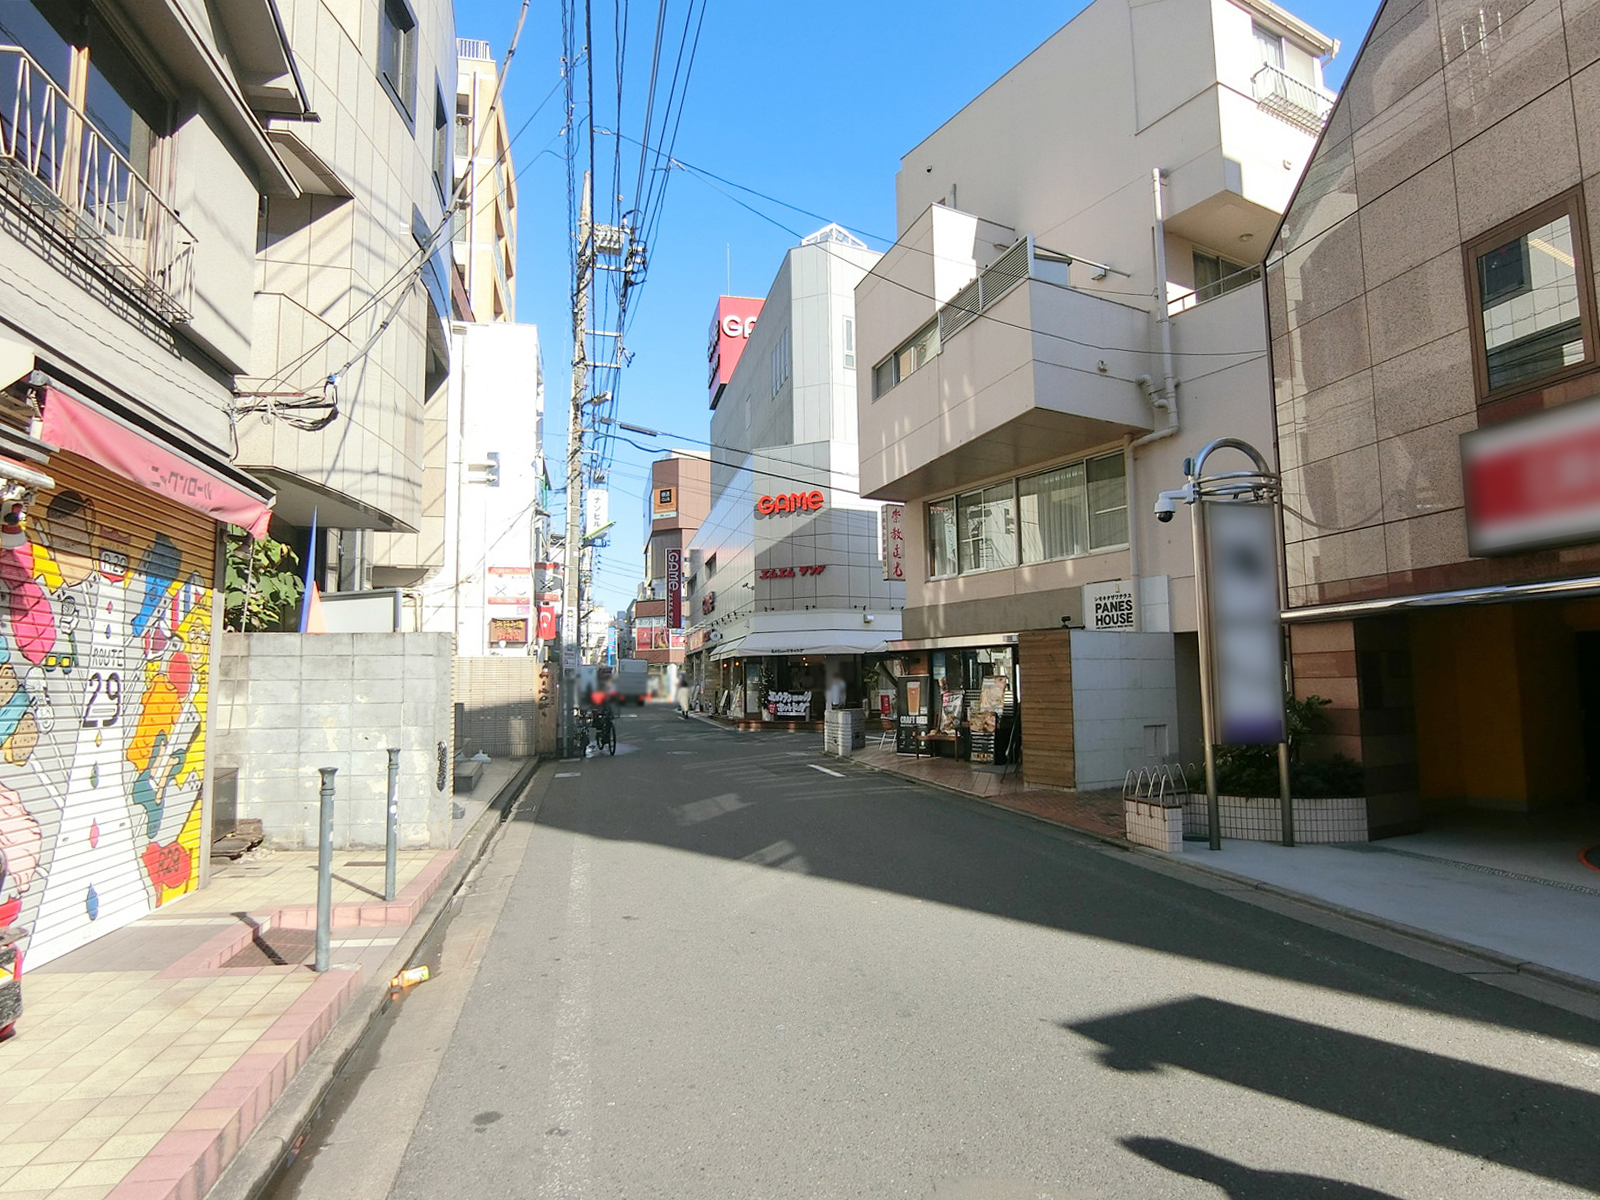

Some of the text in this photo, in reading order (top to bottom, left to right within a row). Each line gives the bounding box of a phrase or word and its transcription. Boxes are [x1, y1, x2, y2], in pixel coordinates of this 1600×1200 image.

[757, 490, 824, 515] GAME
[668, 552, 679, 591] GAME
[1095, 600, 1133, 614] PANES
[1095, 612, 1134, 626] HOUSE
[91, 647, 124, 667] ROUTE
[81, 672, 122, 728] 29
